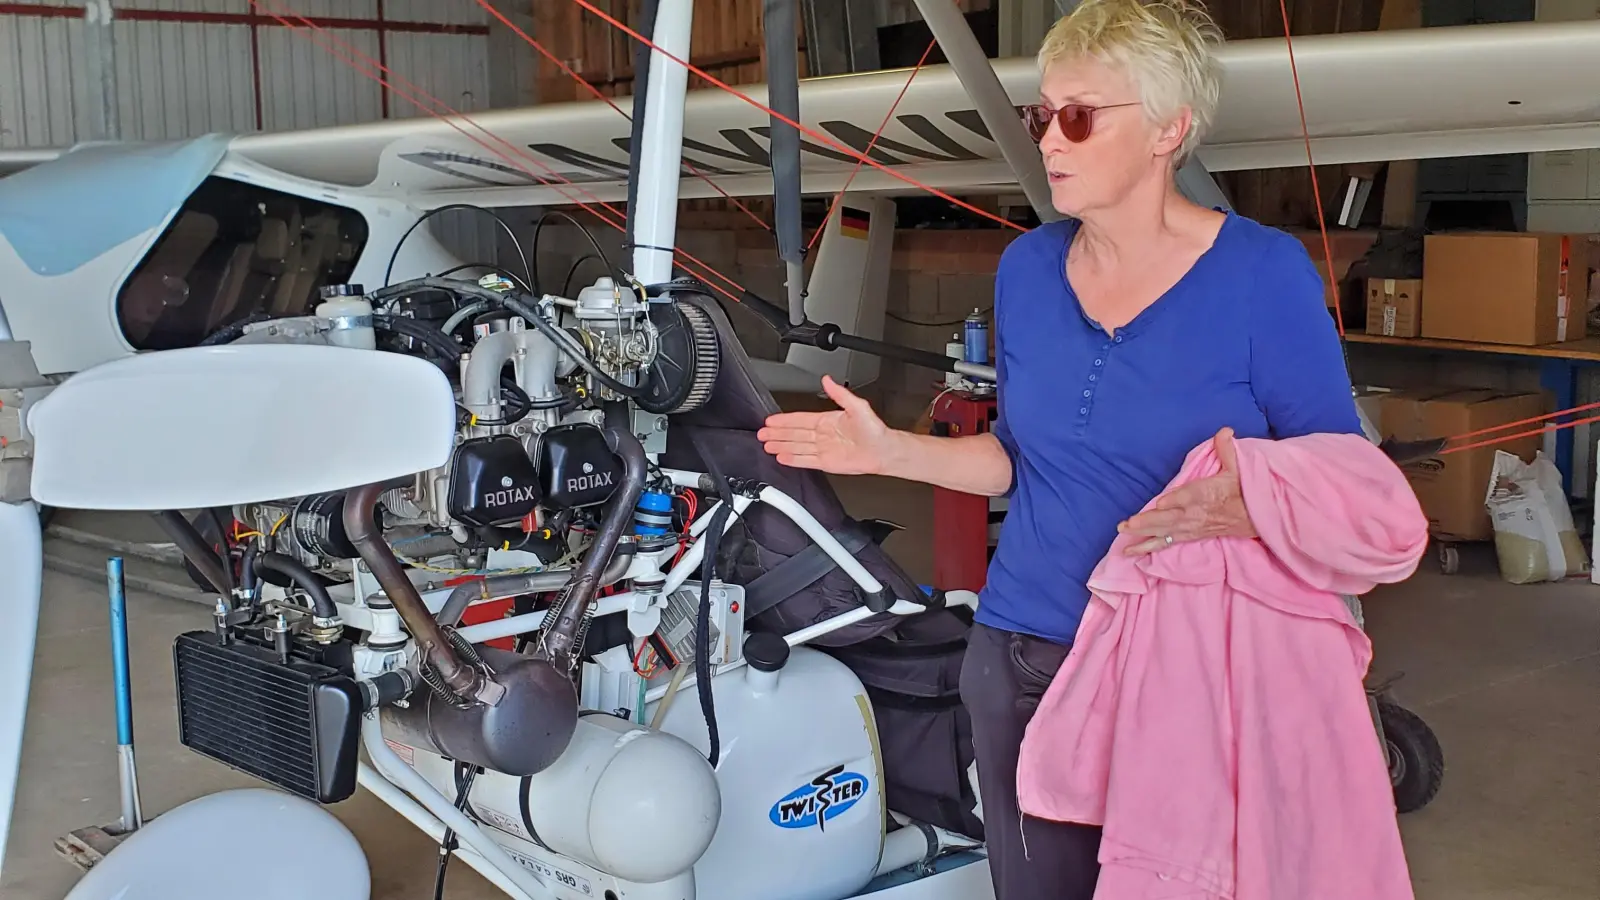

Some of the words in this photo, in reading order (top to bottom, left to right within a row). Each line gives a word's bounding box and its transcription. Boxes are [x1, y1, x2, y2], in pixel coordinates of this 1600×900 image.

[567, 471, 613, 493] ROTAX
[484, 485, 535, 508] ROTAX
[780, 764, 862, 833] TWISTER
[555, 871, 576, 887] GRS
